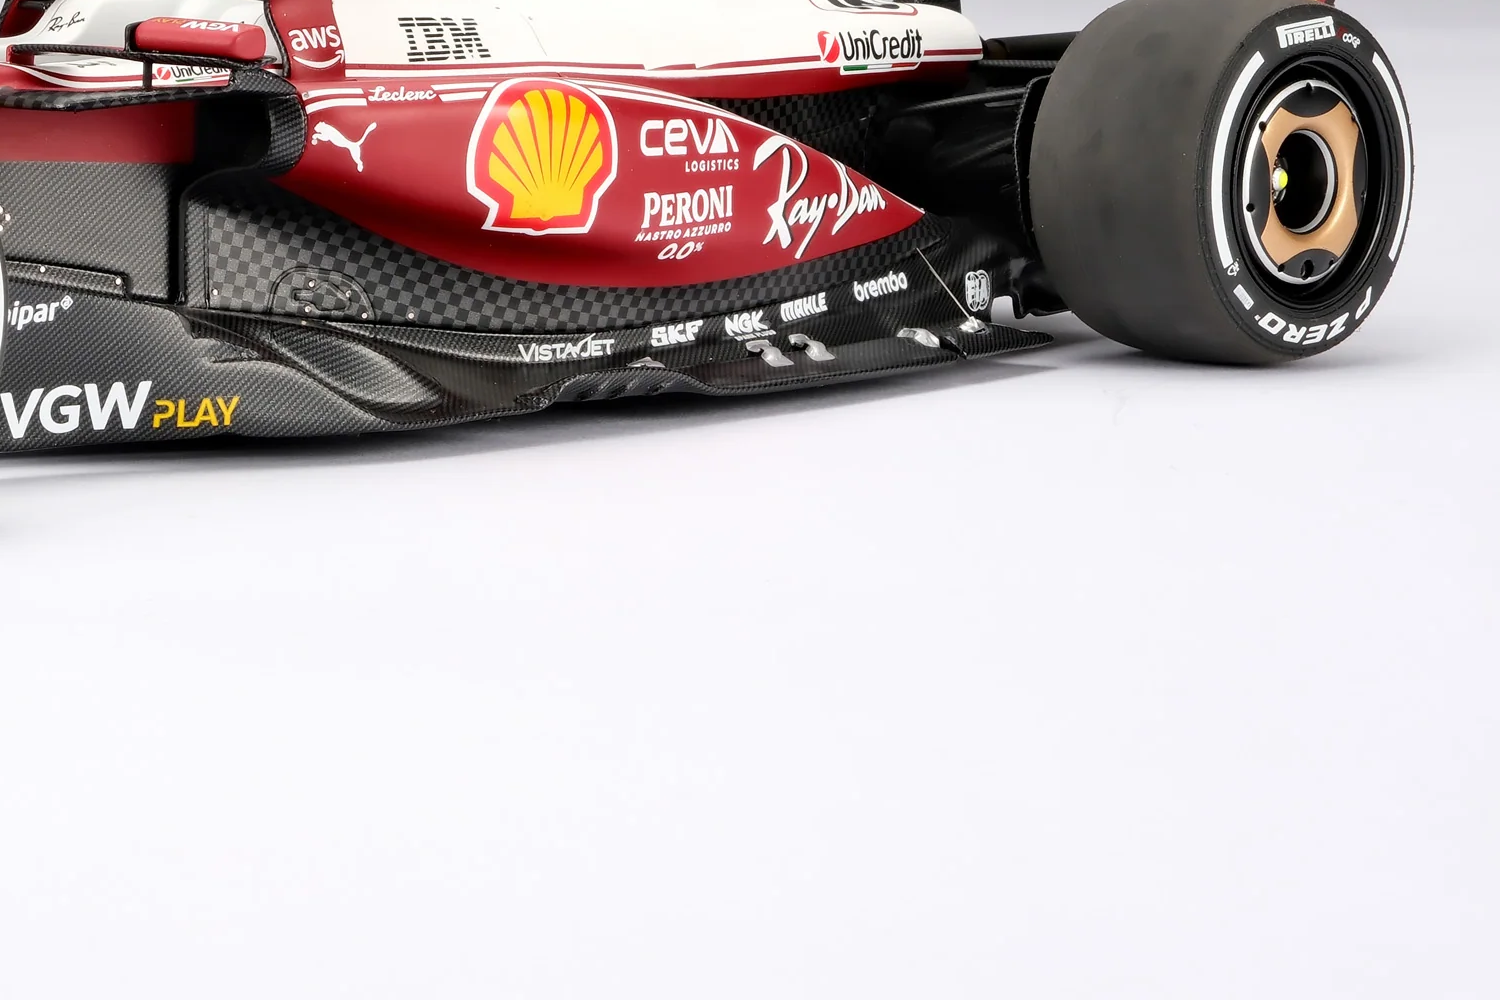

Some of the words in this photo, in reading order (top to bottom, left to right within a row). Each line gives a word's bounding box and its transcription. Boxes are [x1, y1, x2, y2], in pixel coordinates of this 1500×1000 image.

[288, 25, 341, 51] aws
[398, 17, 491, 62] IBM
[839, 29, 922, 61] UniCredit
[1276, 16, 1335, 48] PIRELLI
[368, 85, 437, 102] Leclerc
[685, 159, 739, 172] LOGISTICS
[641, 185, 733, 228] PERONI
[635, 229, 681, 241] NASTRO
[683, 221, 731, 238] AZZURRO
[657, 241, 704, 260] 0.0%
[854, 271, 907, 302] brembo
[781, 292, 828, 322] MAHLE
[1355, 286, 1372, 320] P
[651, 320, 703, 347] SKF
[725, 310, 769, 336] NGK
[1257, 312, 1349, 345] ZERO
[0, 381, 152, 439] VGW
[153, 396, 240, 428] PLAY
